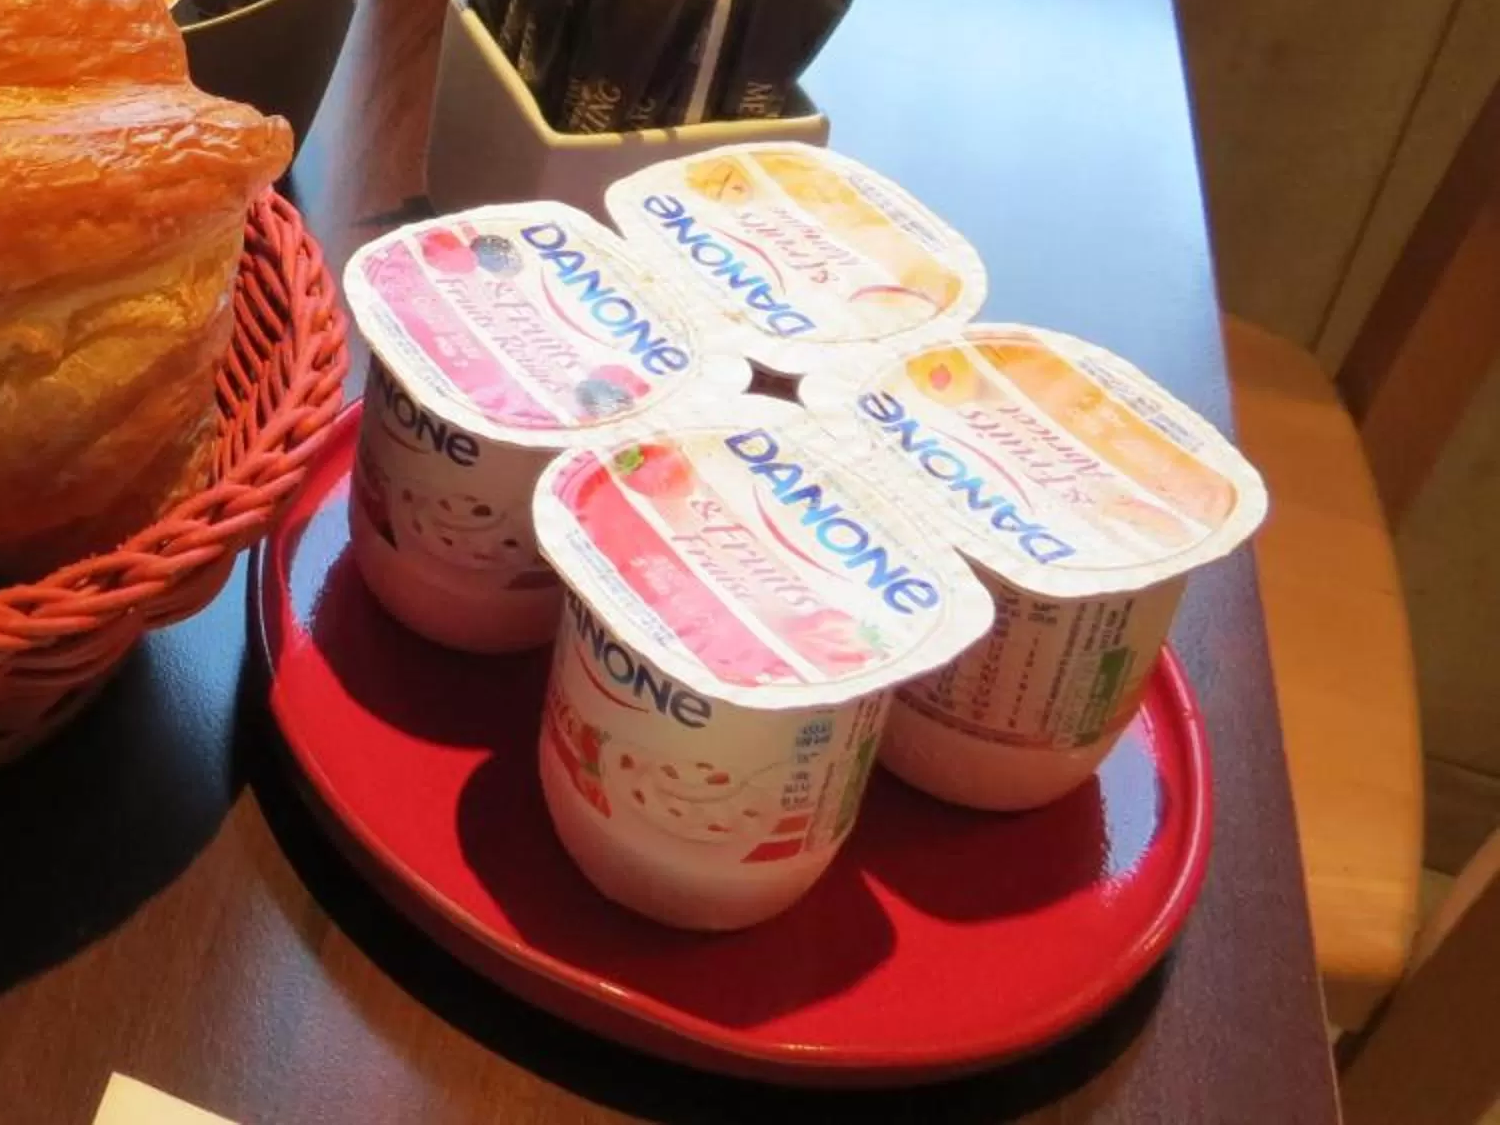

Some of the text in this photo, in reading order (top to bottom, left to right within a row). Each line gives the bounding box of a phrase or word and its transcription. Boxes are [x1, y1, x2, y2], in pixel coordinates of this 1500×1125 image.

[520, 221, 690, 376] DANONE
[642, 194, 818, 338] DANONE
[724, 428, 941, 615] DANONE
[857, 390, 1077, 565] DANONE
